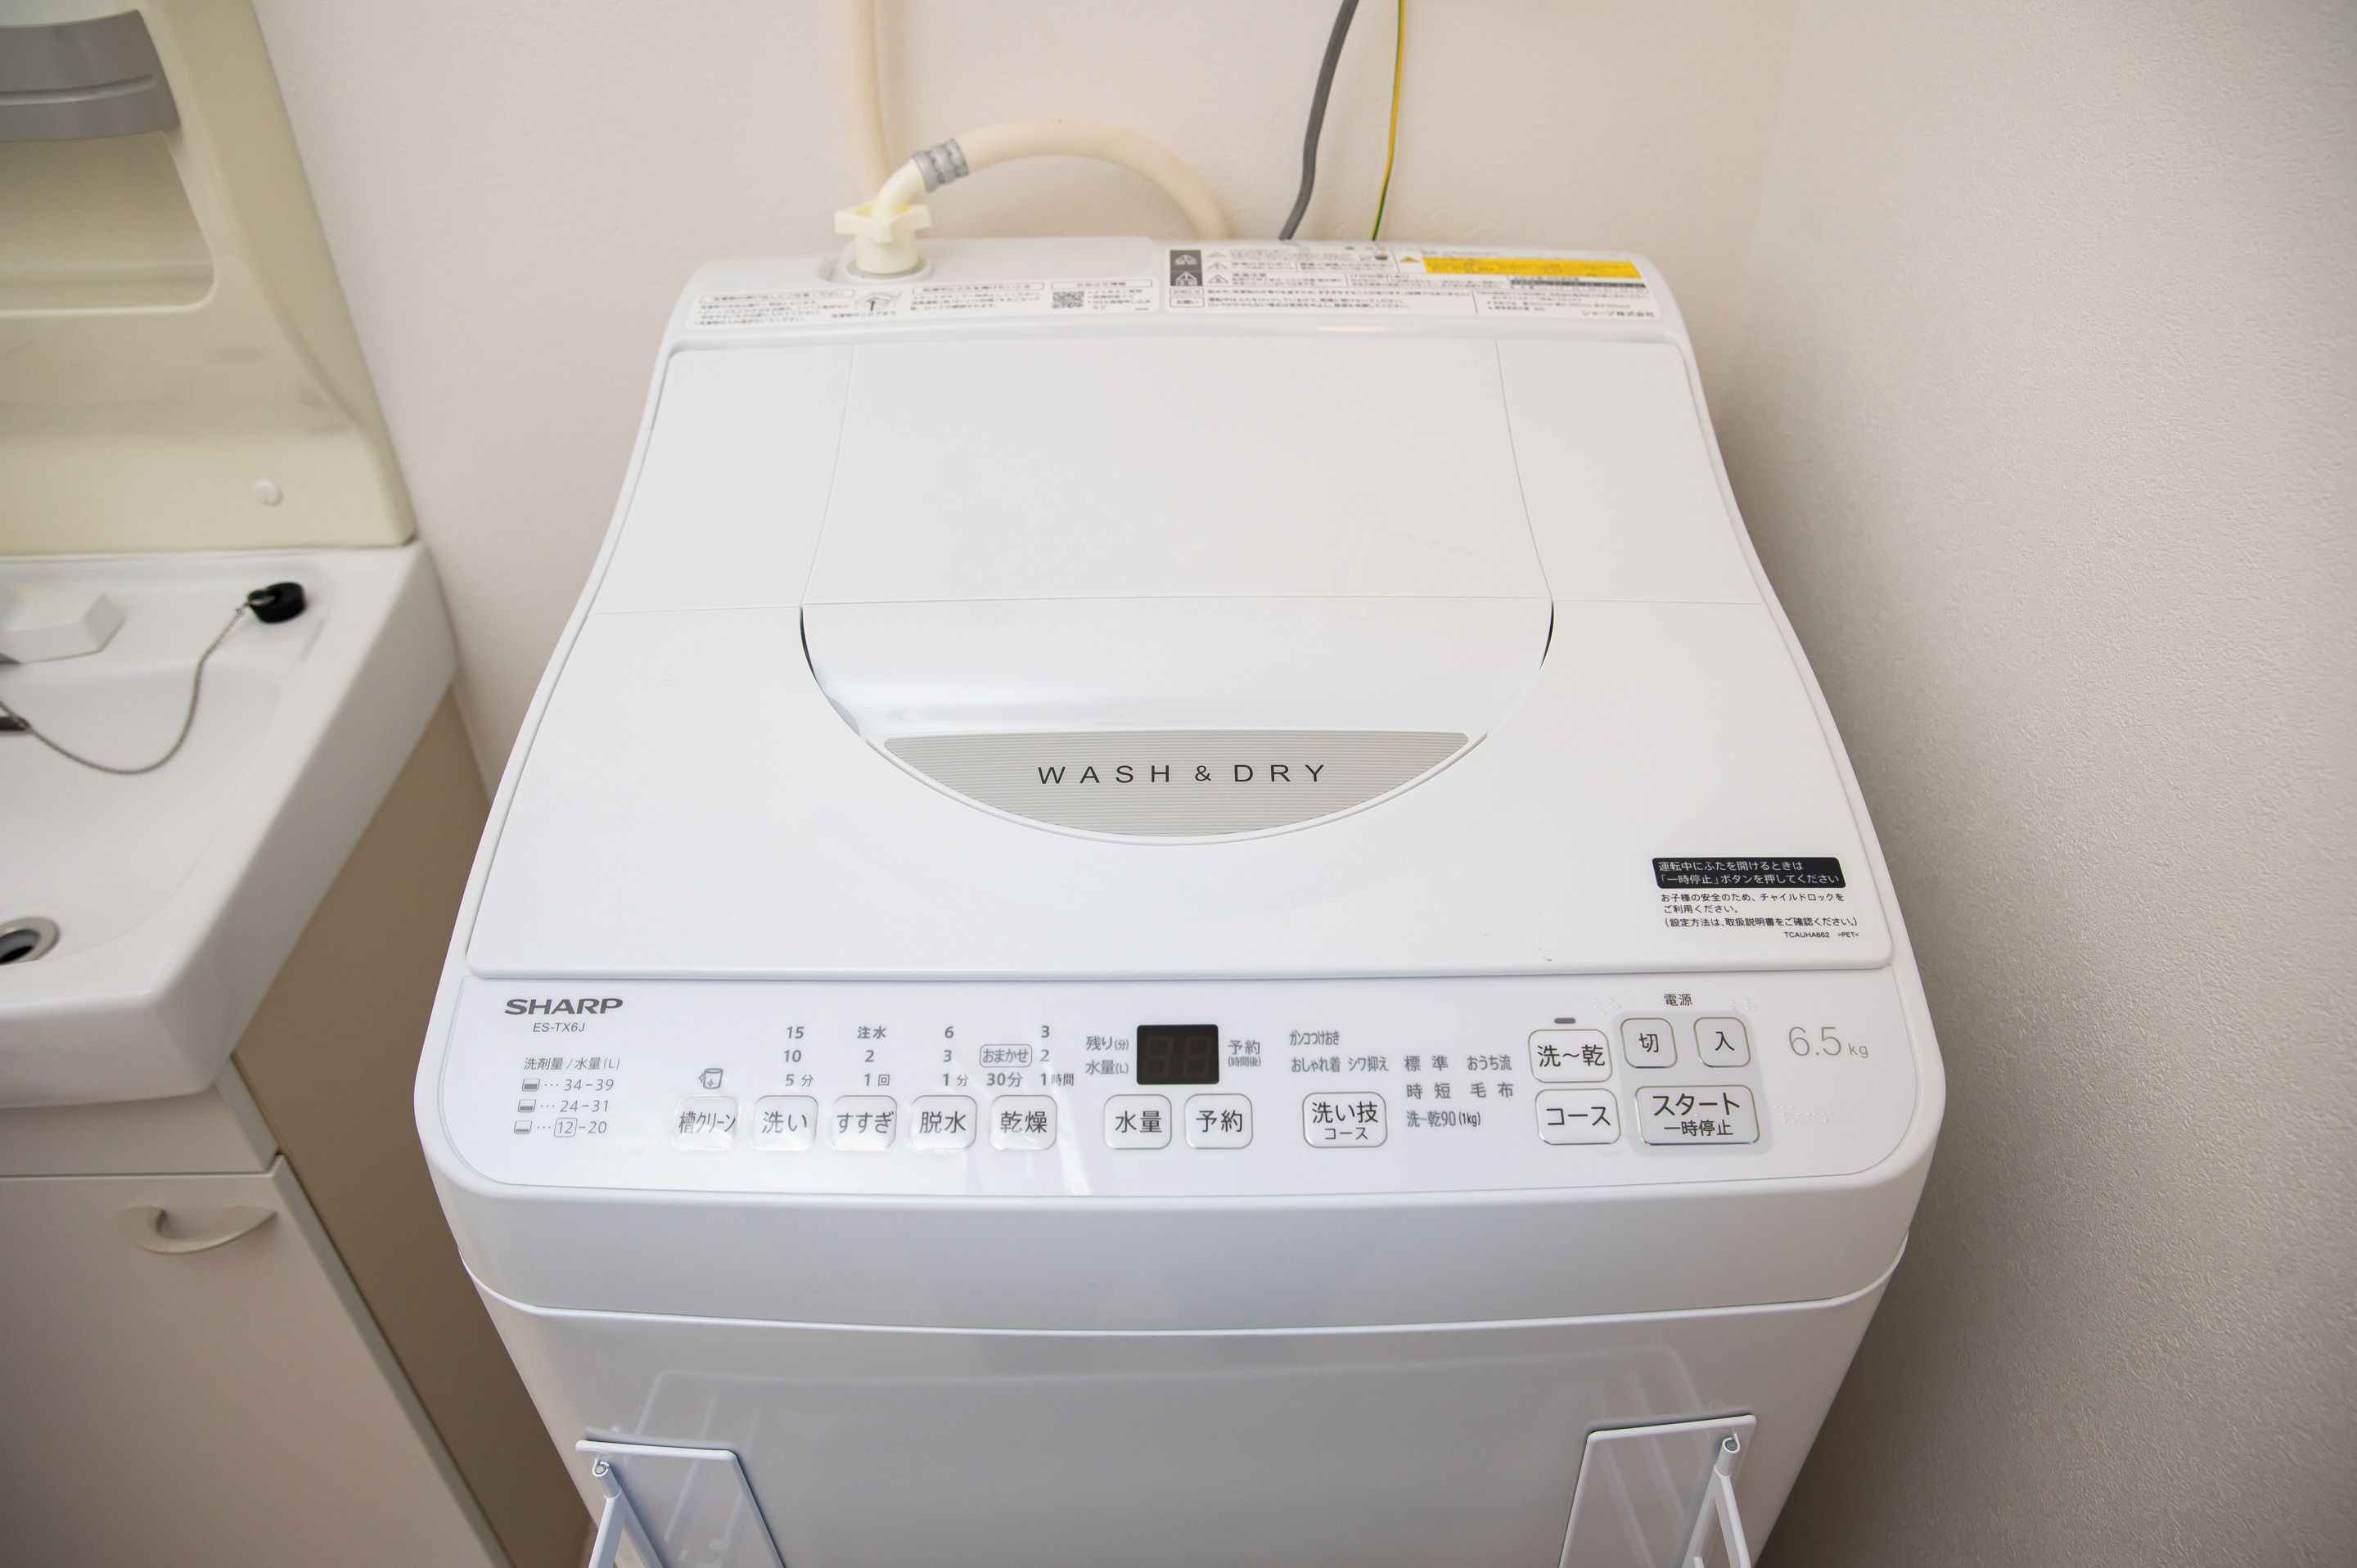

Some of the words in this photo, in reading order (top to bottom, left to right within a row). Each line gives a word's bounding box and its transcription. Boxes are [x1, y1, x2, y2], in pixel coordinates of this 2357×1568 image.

[1037, 764, 1170, 784] WASH
[1194, 764, 1212, 782] &
[1233, 764, 1325, 782] DRY
[1658, 861, 1804, 872] 運転中にふたを開けるときは
[1660, 873, 1840, 885] 「一時停止」ボタンを押してください
[1663, 904, 1739, 914] ご利用ください。
[504, 998, 624, 1016] SHARP
[1664, 994, 1694, 1007] 電源
[533, 1022, 586, 1033] ES-TX6J
[786, 1026, 805, 1039] 15
[857, 1025, 887, 1039] 注水
[944, 1025, 955, 1039] 6
[1041, 1025, 1051, 1039] 3
[1289, 1030, 1341, 1047] ガンコつけおき
[1638, 1033, 1660, 1054] 切
[1715, 1031, 1736, 1052] 入
[1788, 1026, 1842, 1057] 6.5
[1848, 1042, 1869, 1059] kg
[783, 1049, 803, 1063] 10
[864, 1049, 875, 1063] 2
[943, 1049, 953, 1063] 3
[982, 1048, 1030, 1064] おまかせ
[1039, 1049, 1050, 1063] 2
[1227, 1039, 1261, 1056] 予約
[1291, 1057, 1341, 1074] おしゃれ着
[1348, 1055, 1390, 1073] シワ抑え
[1467, 1054, 1513, 1071] おうち流
[986, 1071, 1024, 1088] 30分
[1311, 1101, 1380, 1124] 洗い技
[1652, 1092, 1742, 1117] スタート
[678, 1110, 737, 1134] 槽クリーン
[761, 1111, 809, 1134] 洗い
[836, 1110, 895, 1134] すすぎ
[918, 1110, 967, 1134] 脱水
[999, 1110, 1048, 1134] 乾燥
[1114, 1110, 1163, 1134] 水量
[1196, 1109, 1244, 1134] 予約
[1545, 1106, 1612, 1127] コース
[1324, 1127, 1369, 1141] コース
[1663, 1119, 1734, 1138] 一時停止
